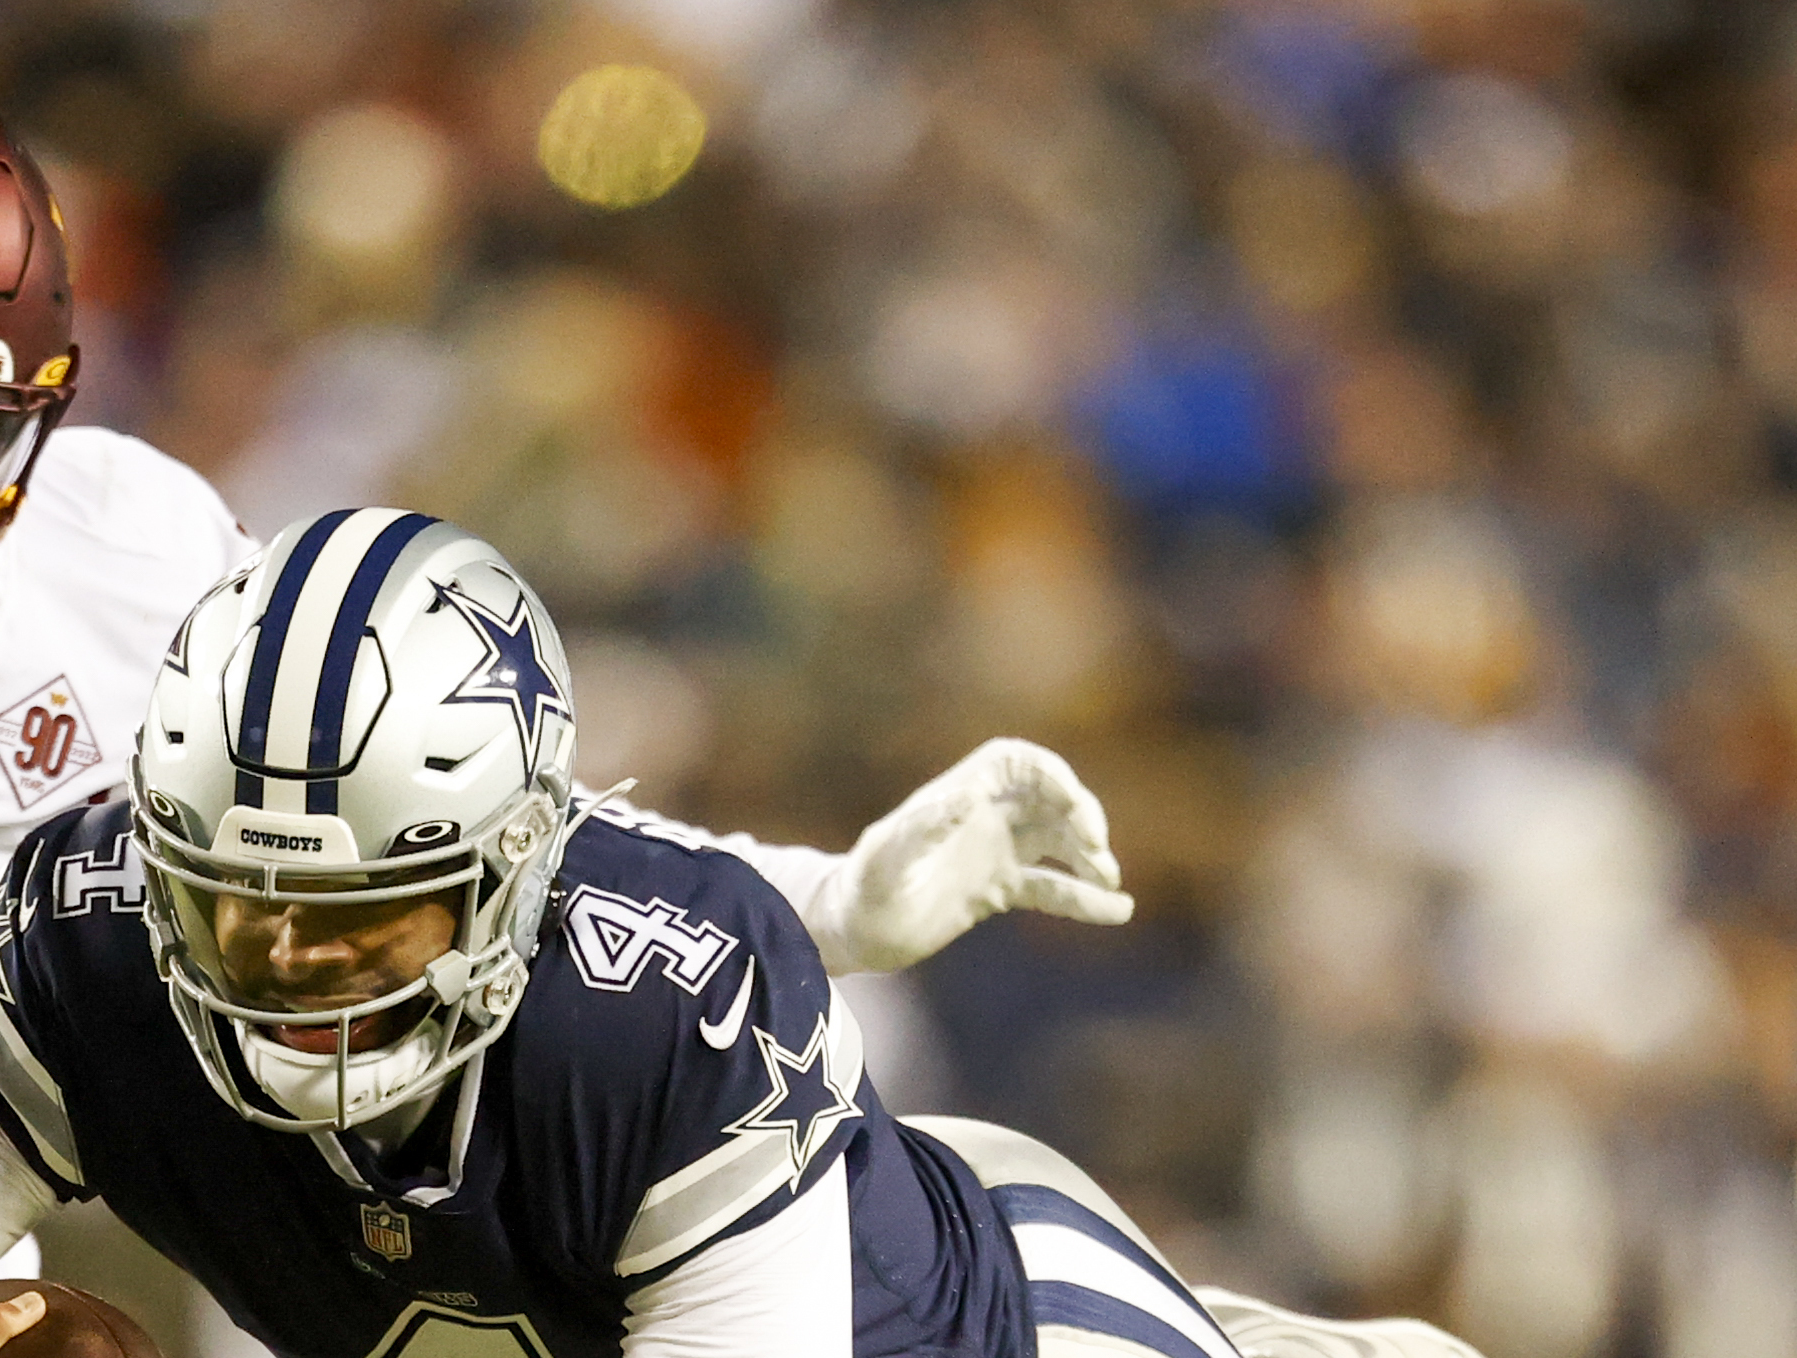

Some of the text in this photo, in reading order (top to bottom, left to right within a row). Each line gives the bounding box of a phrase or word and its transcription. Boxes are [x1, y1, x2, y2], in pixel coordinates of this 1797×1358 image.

[14, 706, 77, 779] 90
[240, 828, 323, 852] COWBOYS
[561, 882, 740, 997] 4
